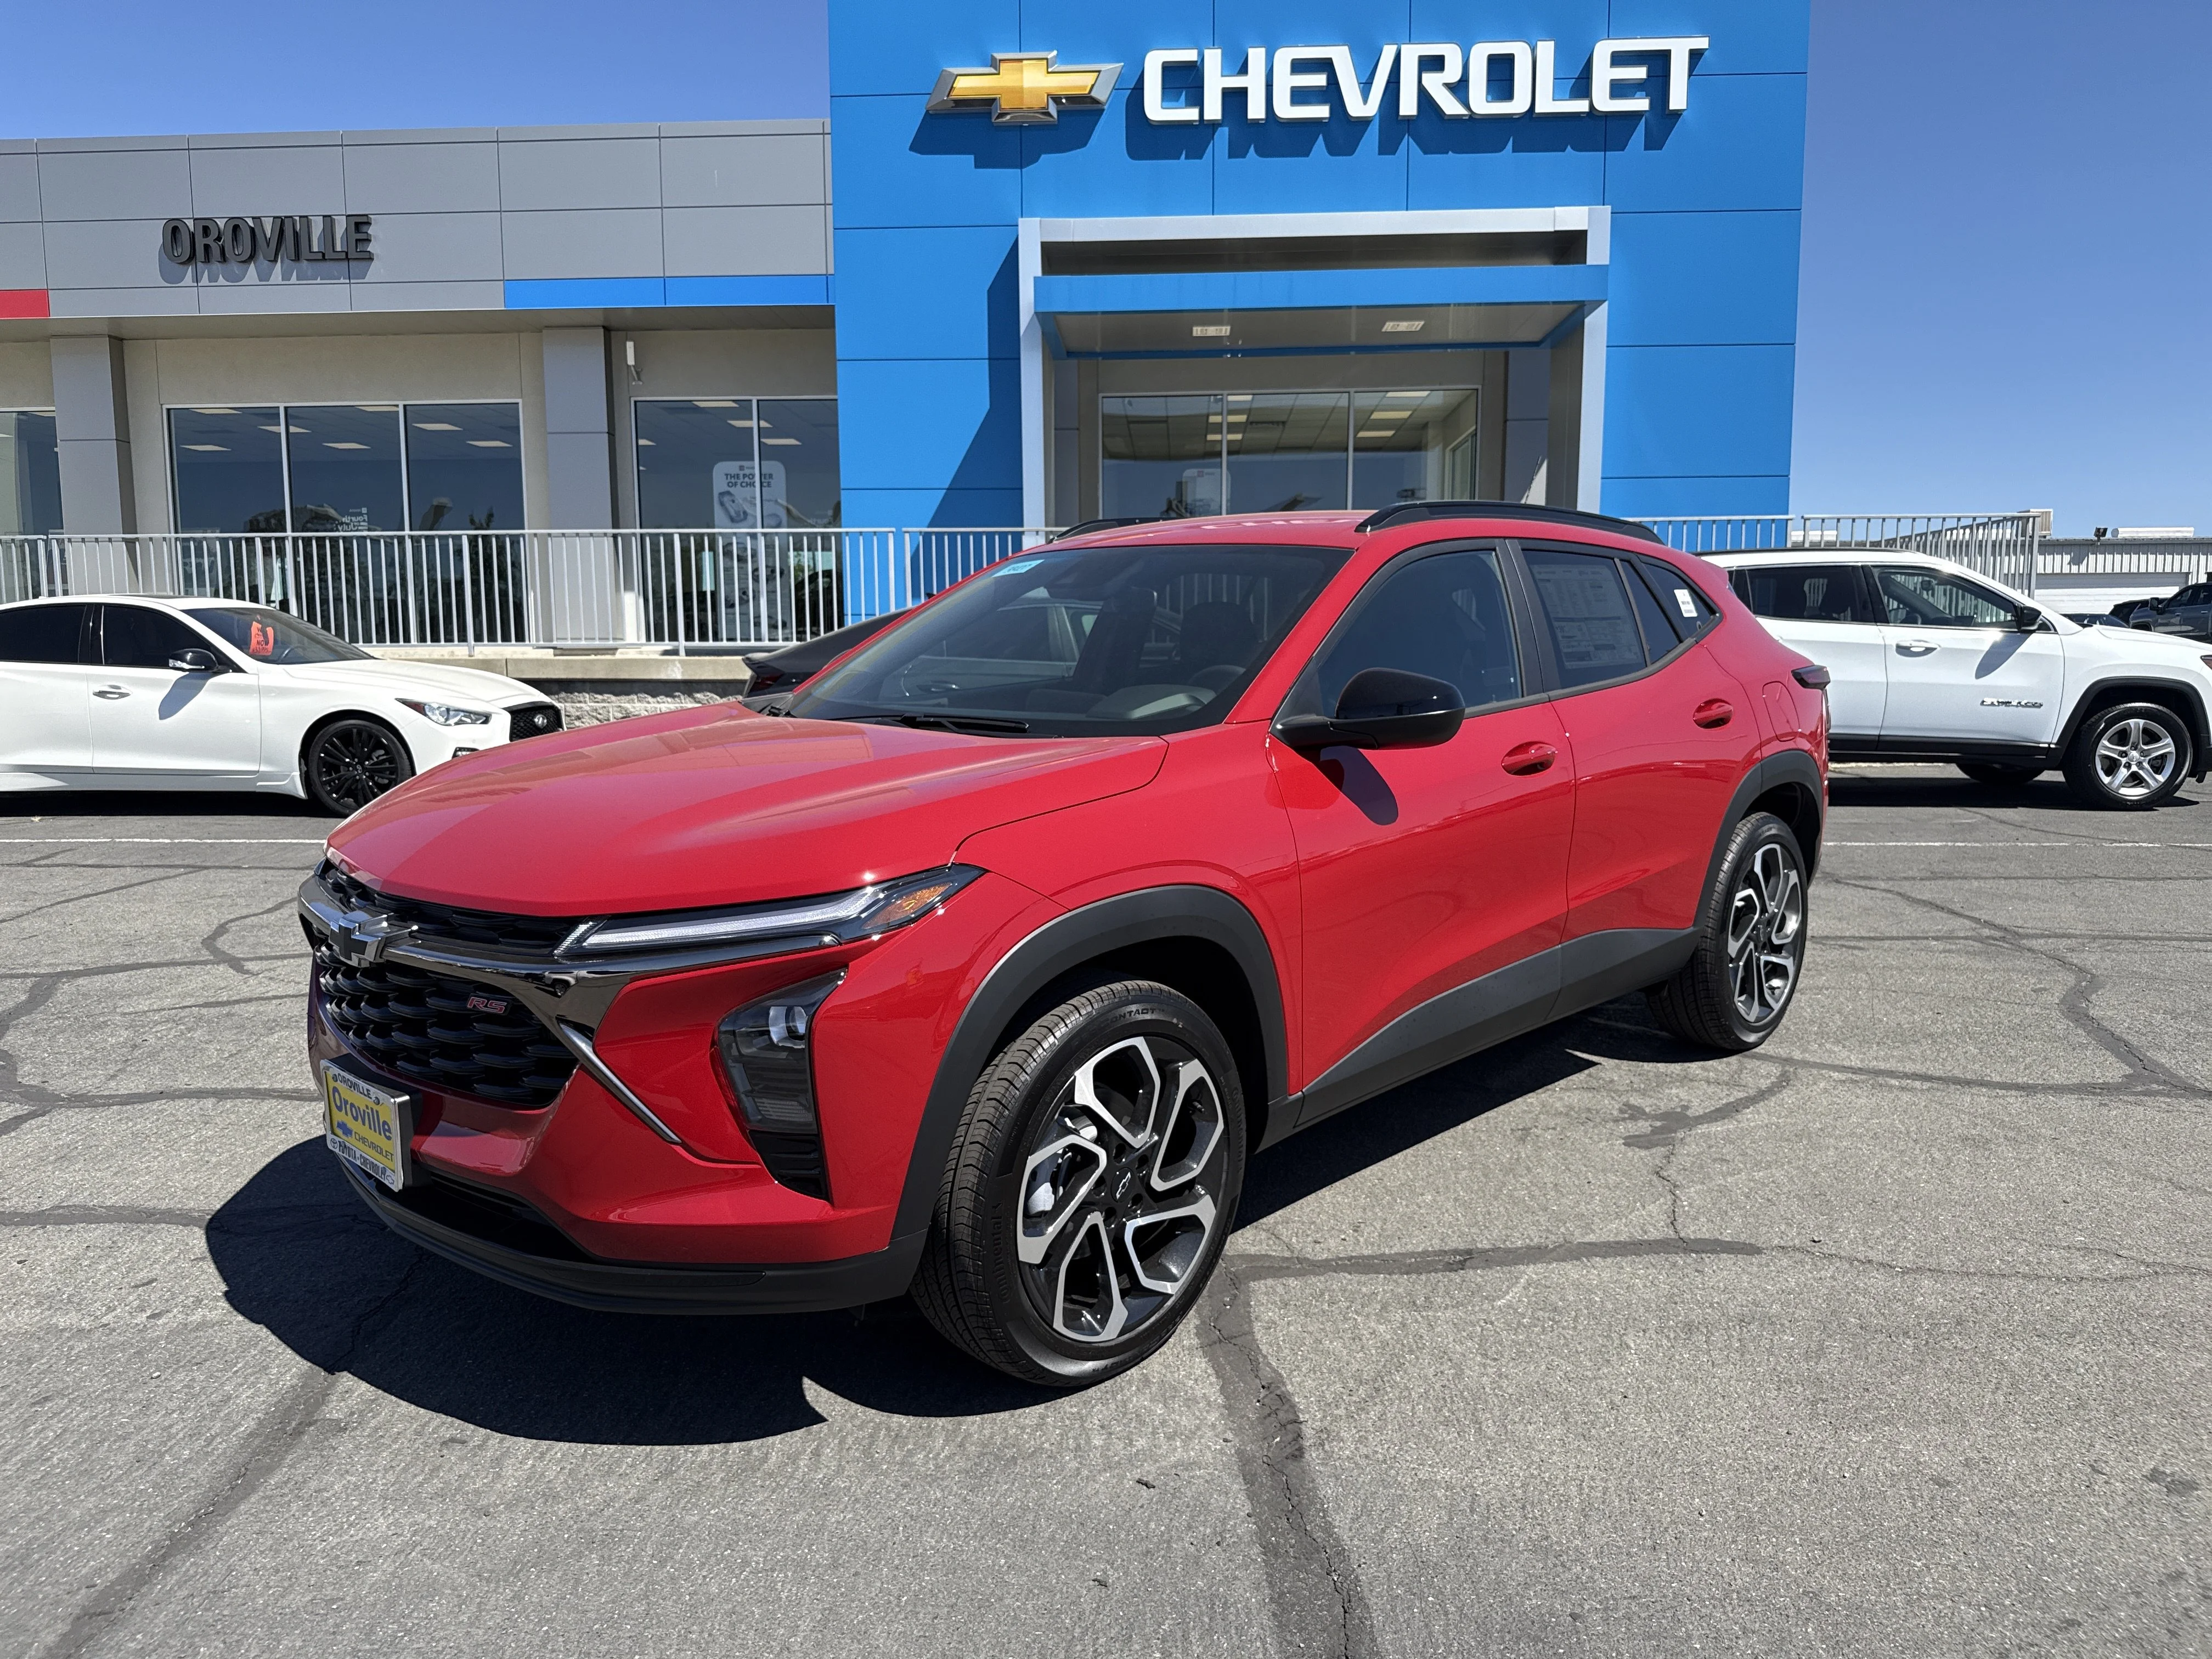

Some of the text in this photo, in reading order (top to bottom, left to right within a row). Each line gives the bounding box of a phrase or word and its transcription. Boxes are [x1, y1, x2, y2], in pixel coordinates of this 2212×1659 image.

[1142, 35, 1710, 125] CHEVROLET
[162, 215, 374, 264] OROVILLE
[467, 996, 507, 1014] RS
[337, 1073, 373, 1100] OROVILLE
[332, 1086, 393, 1141] Oroville
[354, 1131, 394, 1163] CHEVROLET
